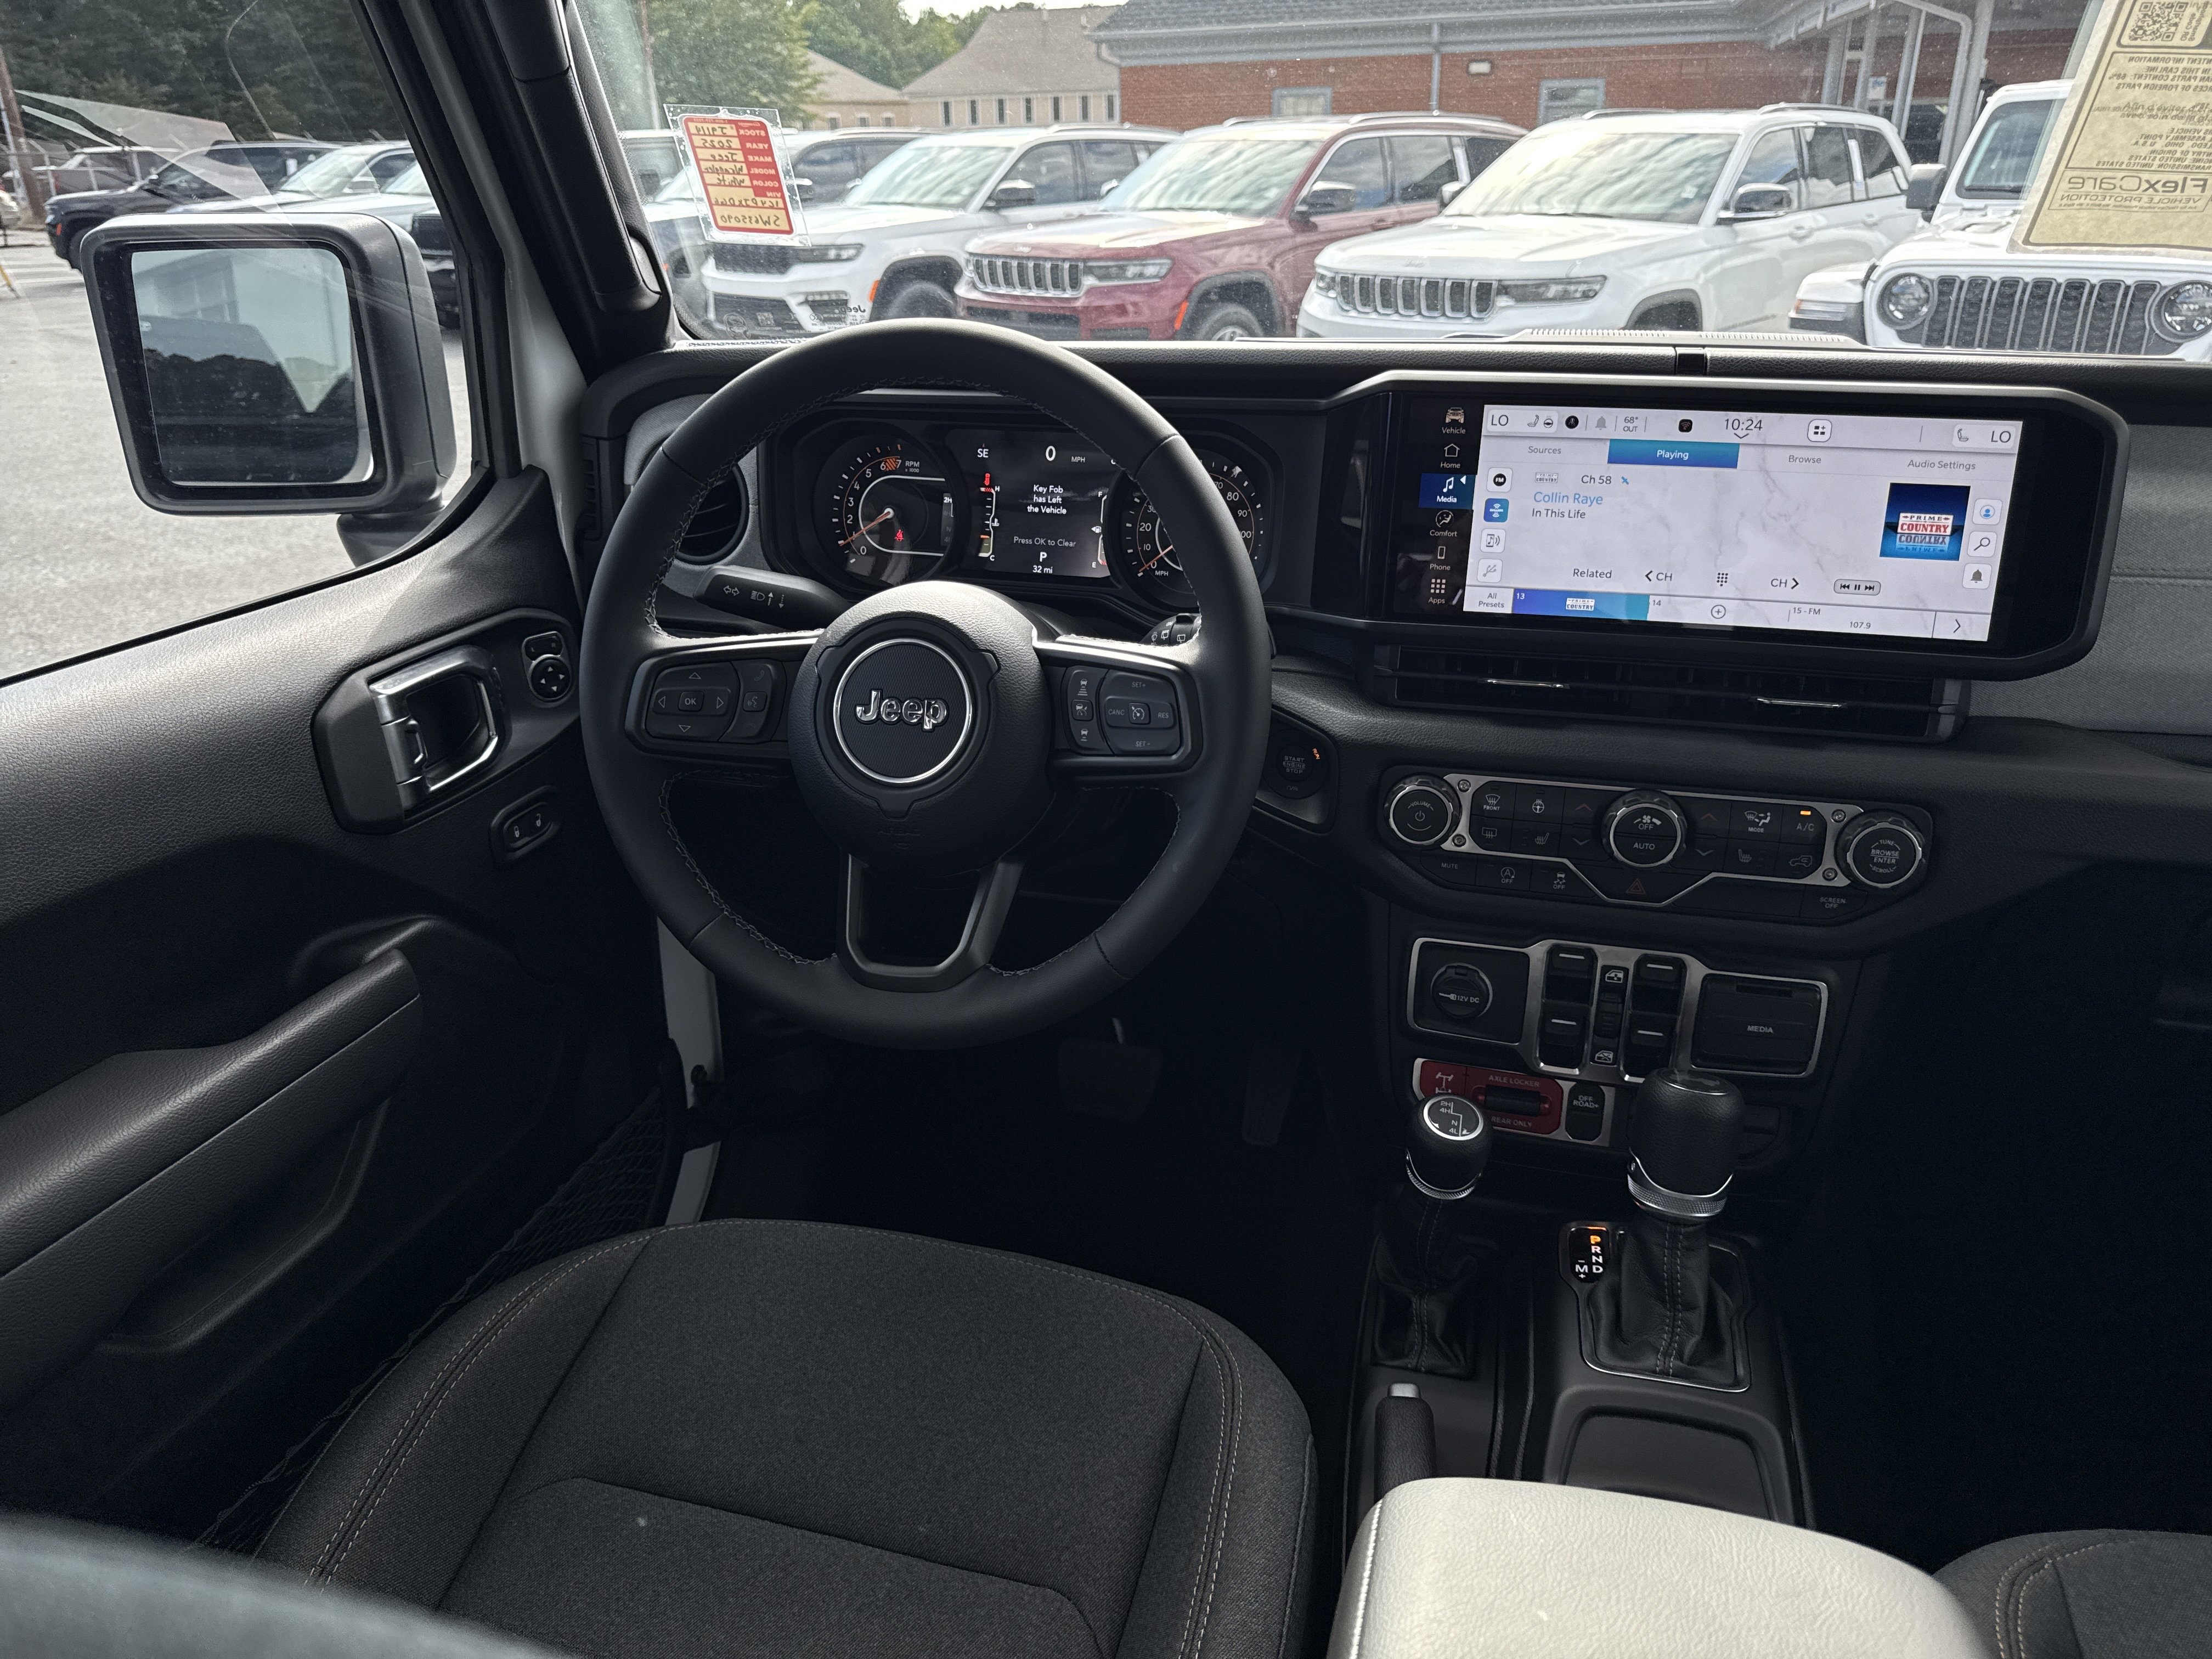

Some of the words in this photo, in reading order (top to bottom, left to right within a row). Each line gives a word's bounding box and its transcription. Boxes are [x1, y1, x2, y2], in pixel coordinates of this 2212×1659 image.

[1491, 414, 1509, 426] LO
[1724, 418, 1763, 431] 10:24
[1990, 430, 2011, 443] LO
[977, 449, 989, 458] SE
[1045, 445, 1056, 461] 0
[1528, 445, 1561, 455] Sources
[1656, 449, 1689, 460] Playing
[1788, 455, 1822, 464] Browse
[880, 461, 887, 471] 6
[1908, 460, 1936, 468] Audio
[1937, 461, 1976, 471] Settings
[865, 469, 872, 478] 5
[1581, 475, 1596, 484] Ch
[1598, 476, 1612, 484] 58
[854, 481, 860, 490] 4
[1033, 484, 1047, 494] Key
[1226, 492, 1239, 501] 80
[1534, 492, 1569, 504] Collin
[1573, 493, 1603, 507] Raye
[848, 498, 854, 507] 3
[1040, 506, 1066, 515] Vehicle
[1532, 509, 1541, 518] In
[1545, 509, 1566, 518] This
[1568, 509, 1586, 519] Life
[847, 515, 853, 524] 2
[1139, 523, 1152, 532] 20
[1900, 523, 1949, 533] COUNTRY
[1013, 536, 1032, 545] Press
[1057, 539, 1076, 548] Clear
[860, 546, 867, 555] 0
[1039, 552, 1047, 562] P
[1032, 565, 1042, 573] 32
[1150, 561, 1157, 569] 0
[1573, 568, 1612, 579] Related
[1656, 572, 1673, 582] CH
[1770, 578, 1787, 588] CH
[1849, 621, 1871, 629] 107.9
[855, 690, 948, 730] Jeep
[1312, 748, 1321, 759] RUN
[1410, 801, 1432, 809] VOLUME
[1796, 823, 1814, 831] A/C
[1633, 842, 1655, 850] AUTO
[1871, 849, 1900, 857] BROWSE
[1746, 1024, 1773, 1034] MEDIA
[1488, 1075, 1508, 1084] AXLE
[1509, 1077, 1541, 1087] LOCKER
[1491, 1116, 1511, 1125] REAR
[1513, 1118, 1533, 1128] ONLY
[1590, 1235, 1601, 1244] P
[1591, 1245, 1602, 1254] R
[1592, 1255, 1603, 1263] N
[1575, 1264, 1589, 1273] M
[1592, 1265, 1604, 1273] D
